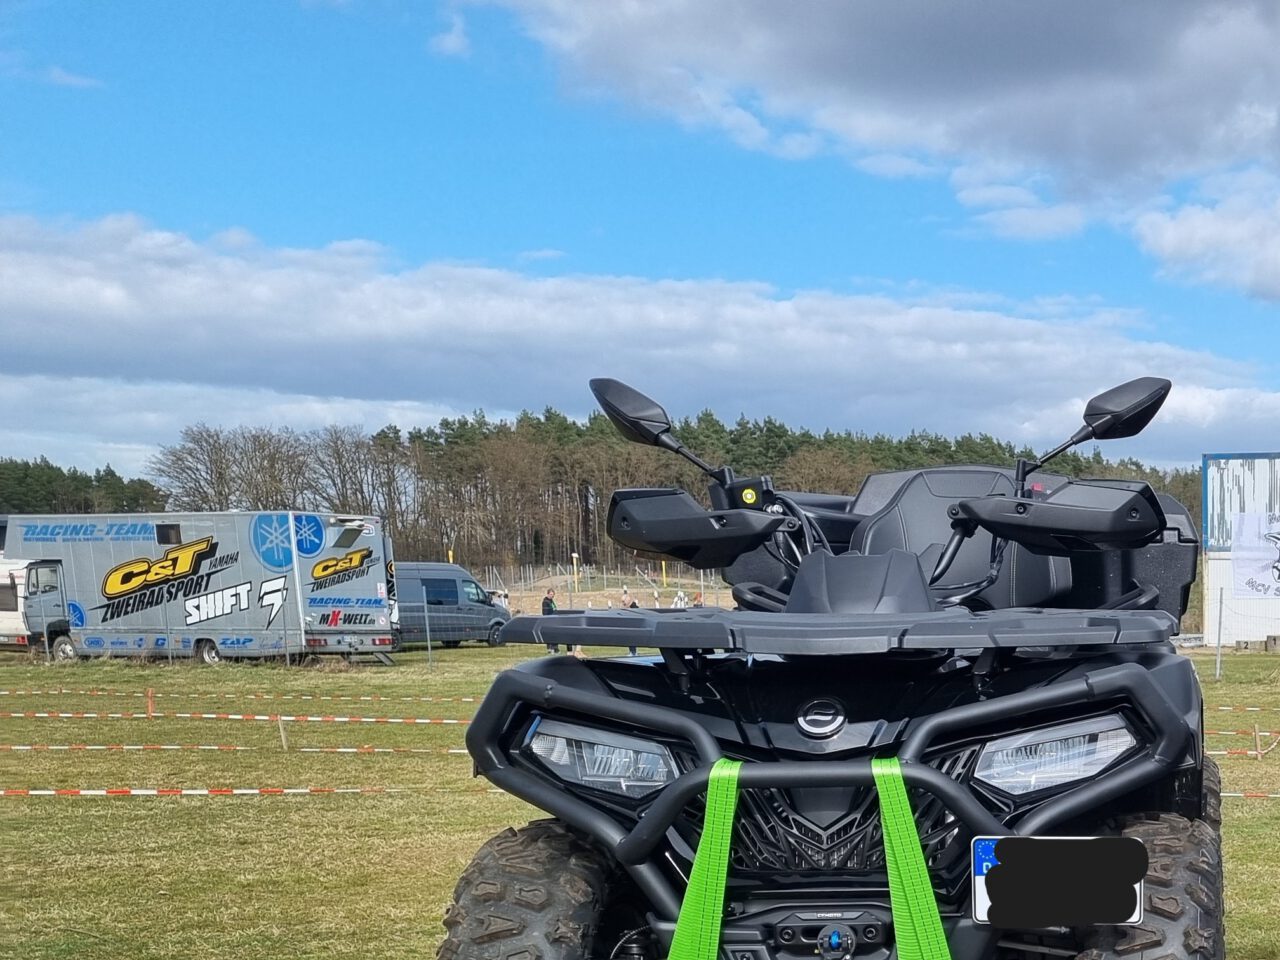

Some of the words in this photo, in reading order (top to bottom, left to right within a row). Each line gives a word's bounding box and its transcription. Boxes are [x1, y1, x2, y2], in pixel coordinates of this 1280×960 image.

[17, 523, 155, 536] RACING-TEAM
[102, 536, 214, 598] C&T
[208, 551, 239, 571] YAMAHA
[312, 547, 372, 580] C&T
[307, 565, 374, 592] ZWEIRADSPORT
[1245, 578, 1271, 594] MCV
[93, 568, 224, 623] ZWEIRADSPORT
[185, 581, 252, 626] SHIFT
[307, 597, 384, 605] RACING-TEAM
[1243, 641, 1249, 650] 2
[982, 862, 992, 873] D
